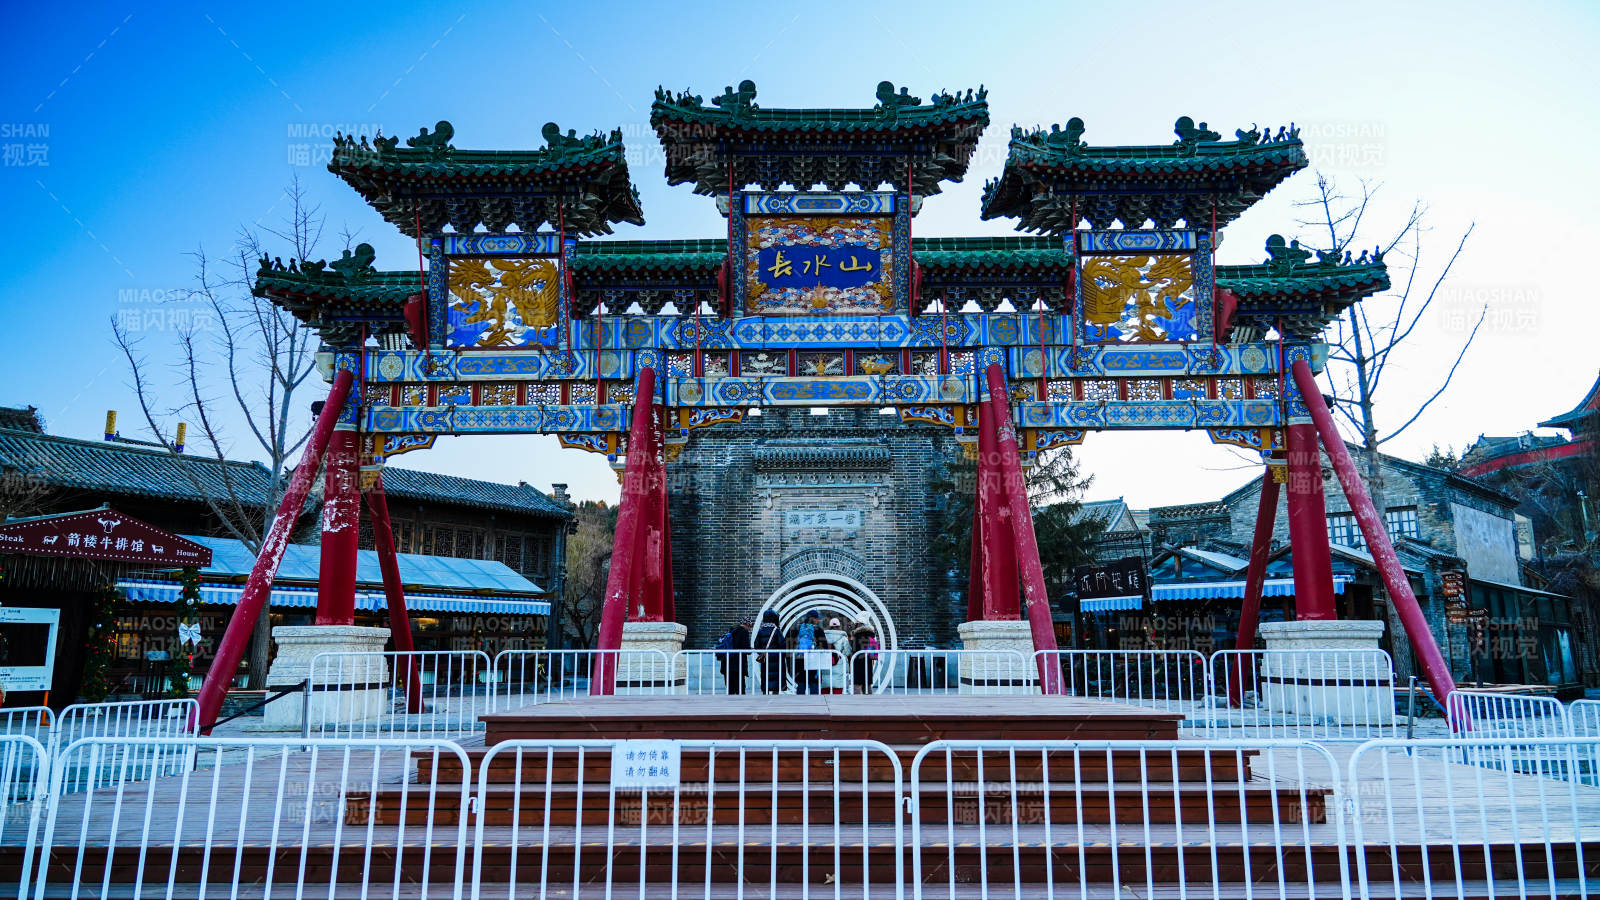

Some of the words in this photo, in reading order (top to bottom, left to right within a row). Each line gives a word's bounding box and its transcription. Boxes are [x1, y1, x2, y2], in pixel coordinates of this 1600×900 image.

[0, 534, 24, 543] Steak
[67, 533, 145, 553] 箭楼牛排馆
[176, 549, 199, 558] House
[625, 750, 670, 761] 请勿倚靠
[625, 766, 670, 777] 请勿翻越
